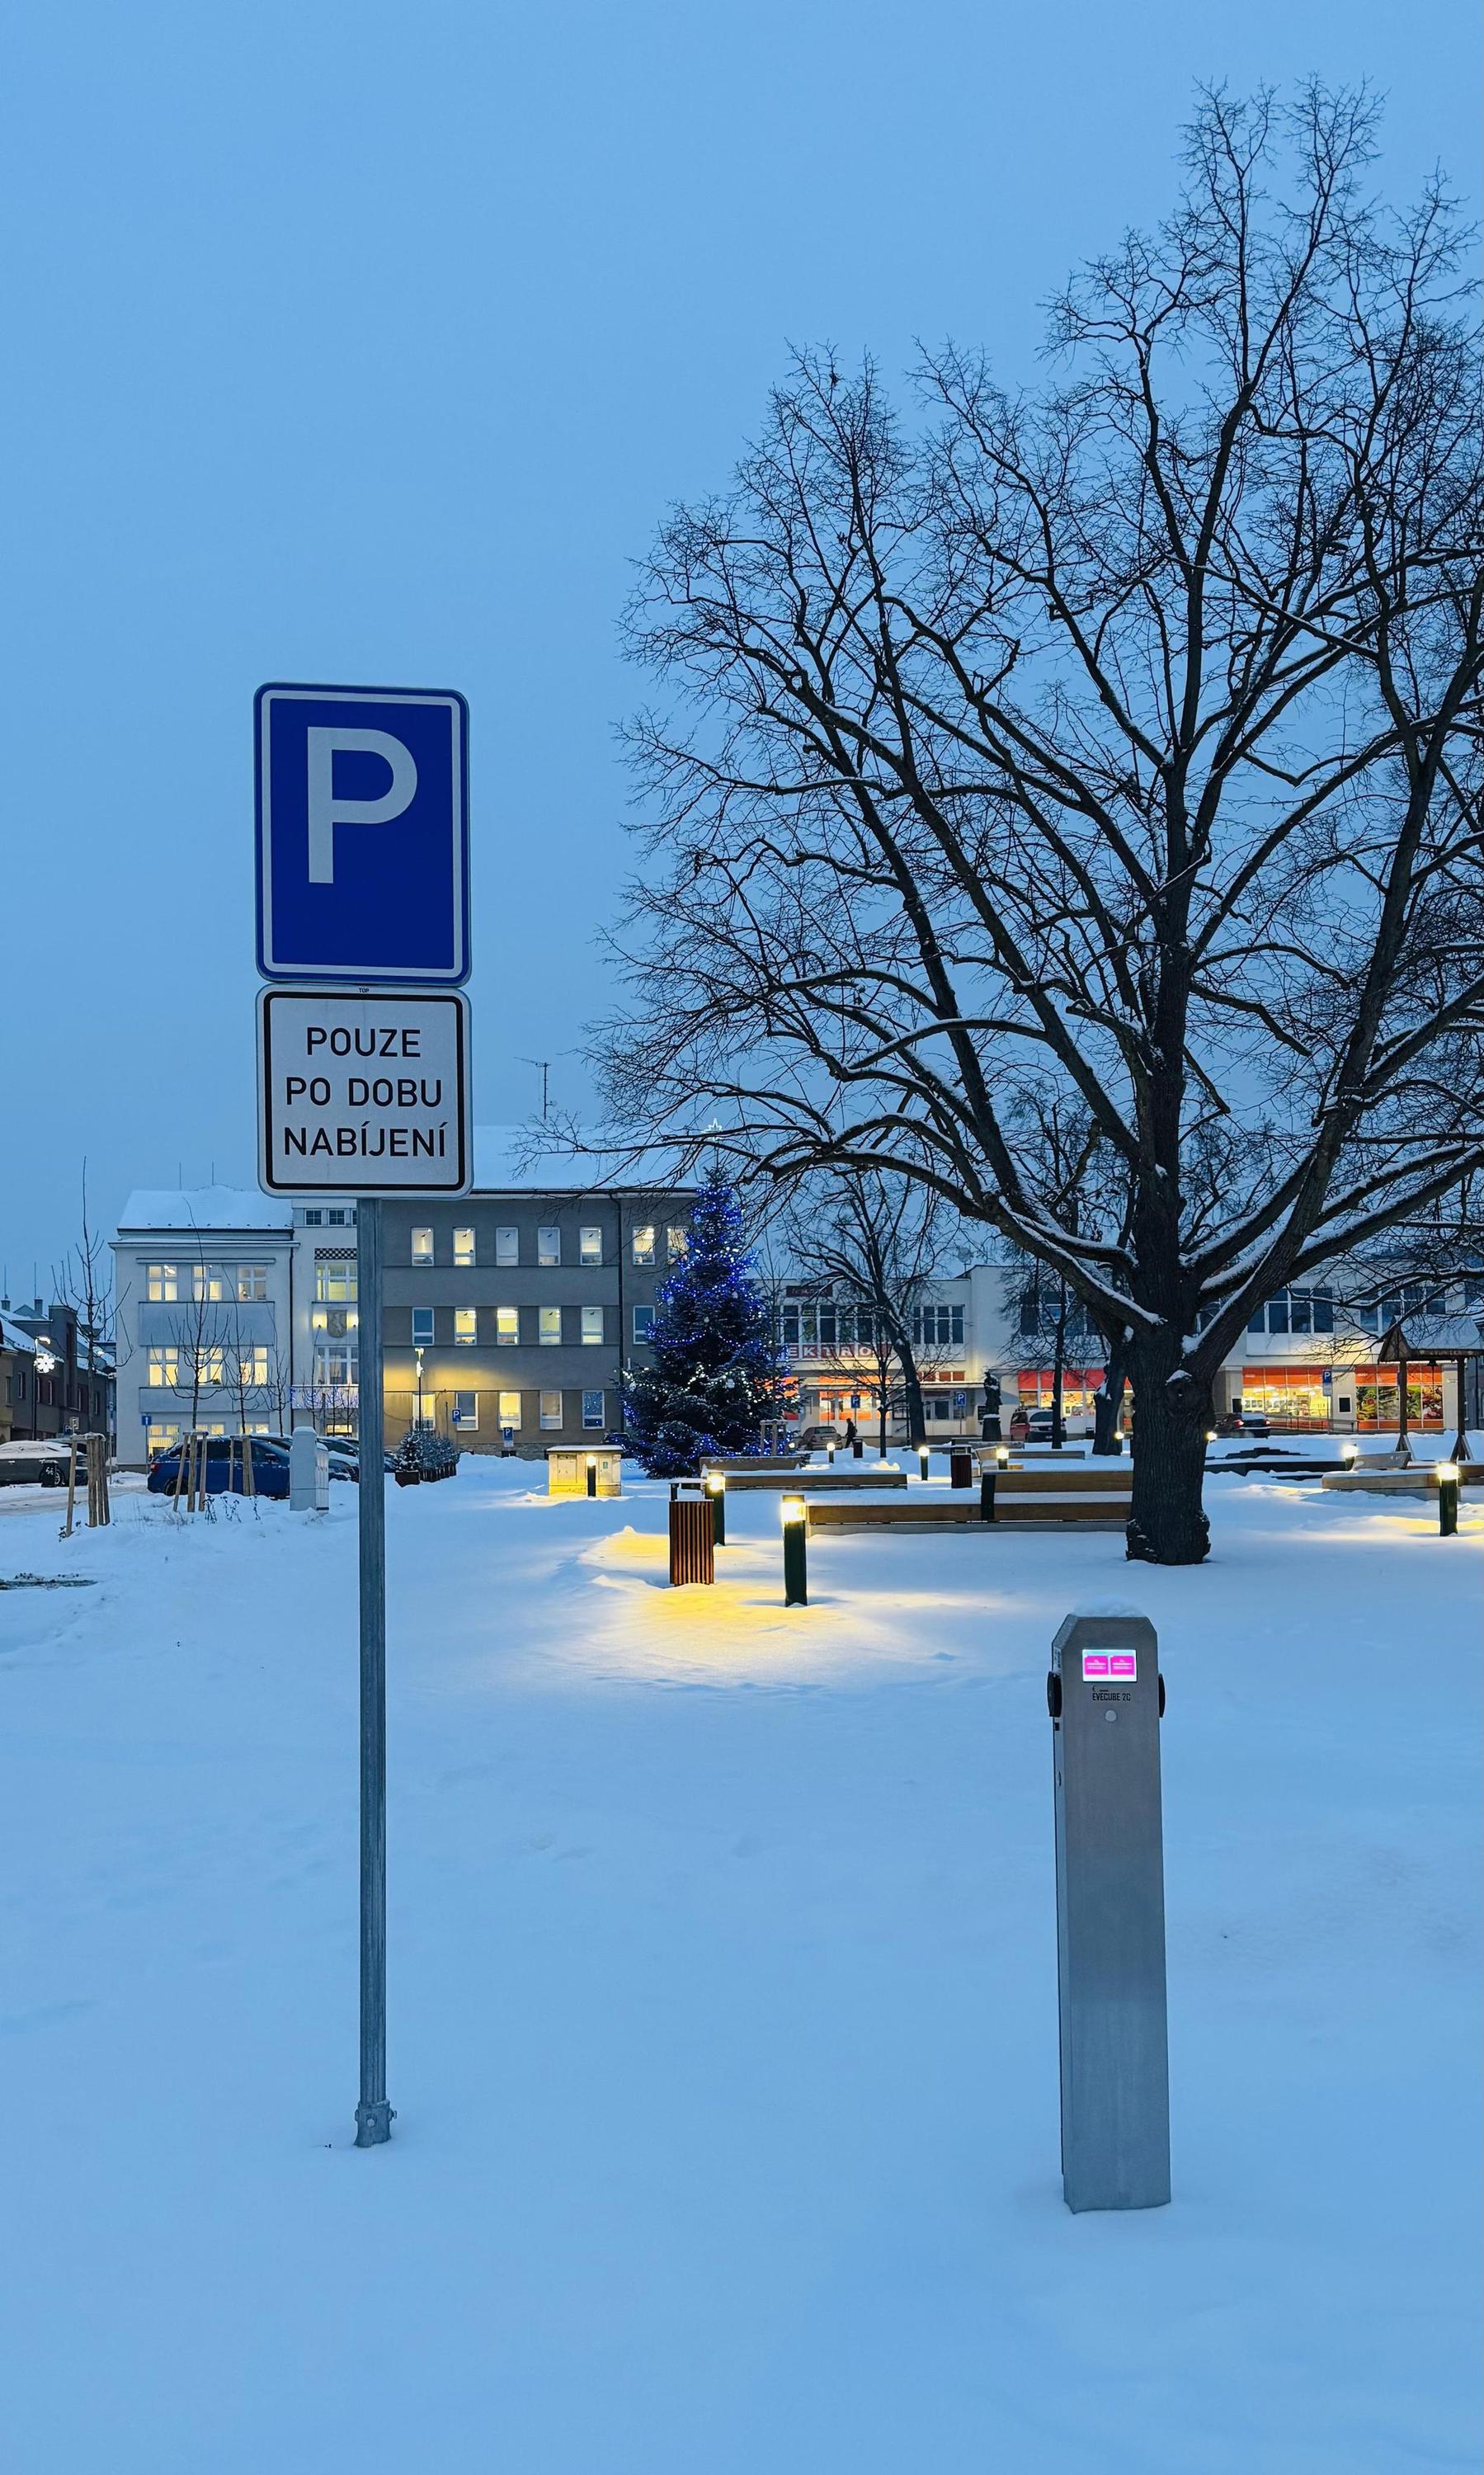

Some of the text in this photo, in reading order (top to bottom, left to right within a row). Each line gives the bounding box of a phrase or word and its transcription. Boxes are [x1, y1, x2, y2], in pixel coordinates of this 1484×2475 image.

[308, 726, 417, 884] P
[306, 1027, 421, 1058] POUZE
[286, 1077, 442, 1107] PO DOBU
[284, 1120, 448, 1157] NABÍJENÍ
[505, 1428, 511, 1436] P
[1092, 1692, 1121, 1701] EVECUBE
